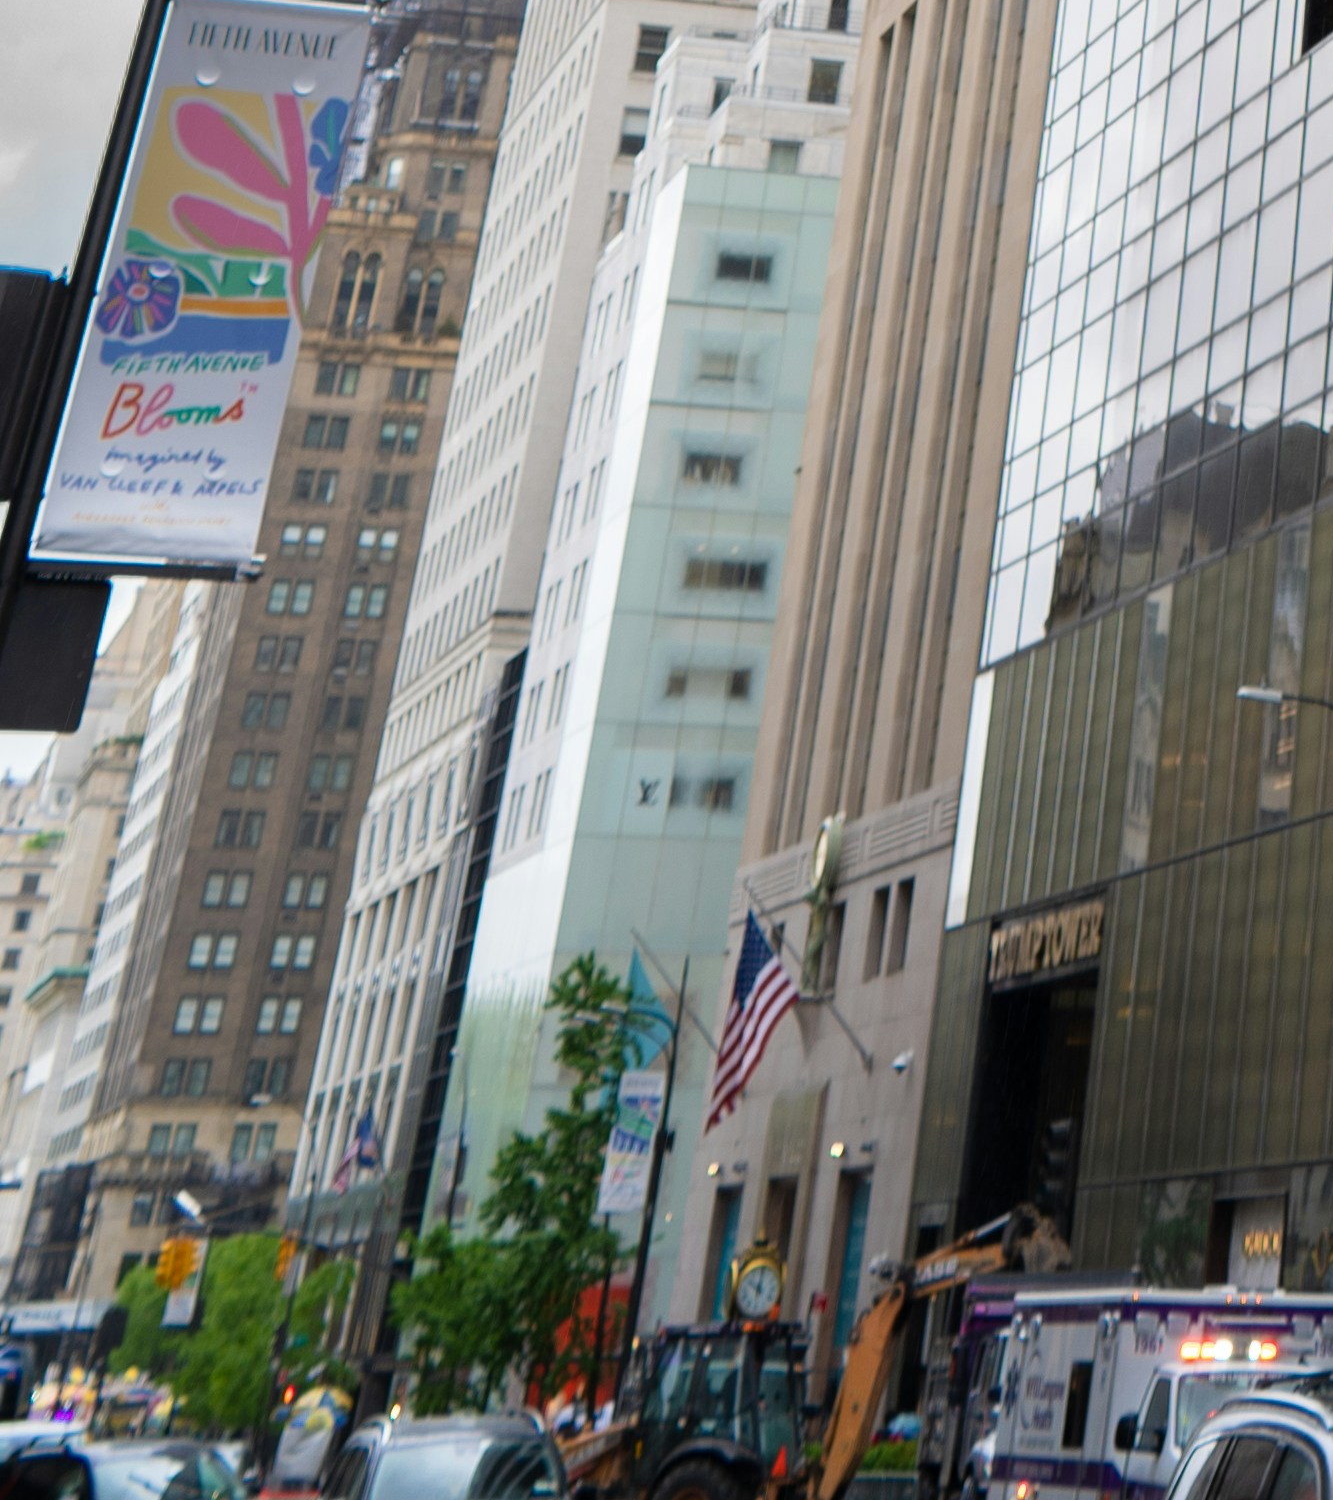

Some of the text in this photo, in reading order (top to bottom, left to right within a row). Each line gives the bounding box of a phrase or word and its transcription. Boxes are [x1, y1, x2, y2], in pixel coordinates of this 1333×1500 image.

[188, 21, 339, 60] FIFTH AVENUE
[111, 353, 265, 375] FIFTH AVENUE
[101, 381, 244, 440] Blooms
[205, 448, 227, 473] by
[60, 472, 99, 490] VAN
[107, 476, 168, 496] CLEEF
[192, 479, 264, 497] ARPELS
